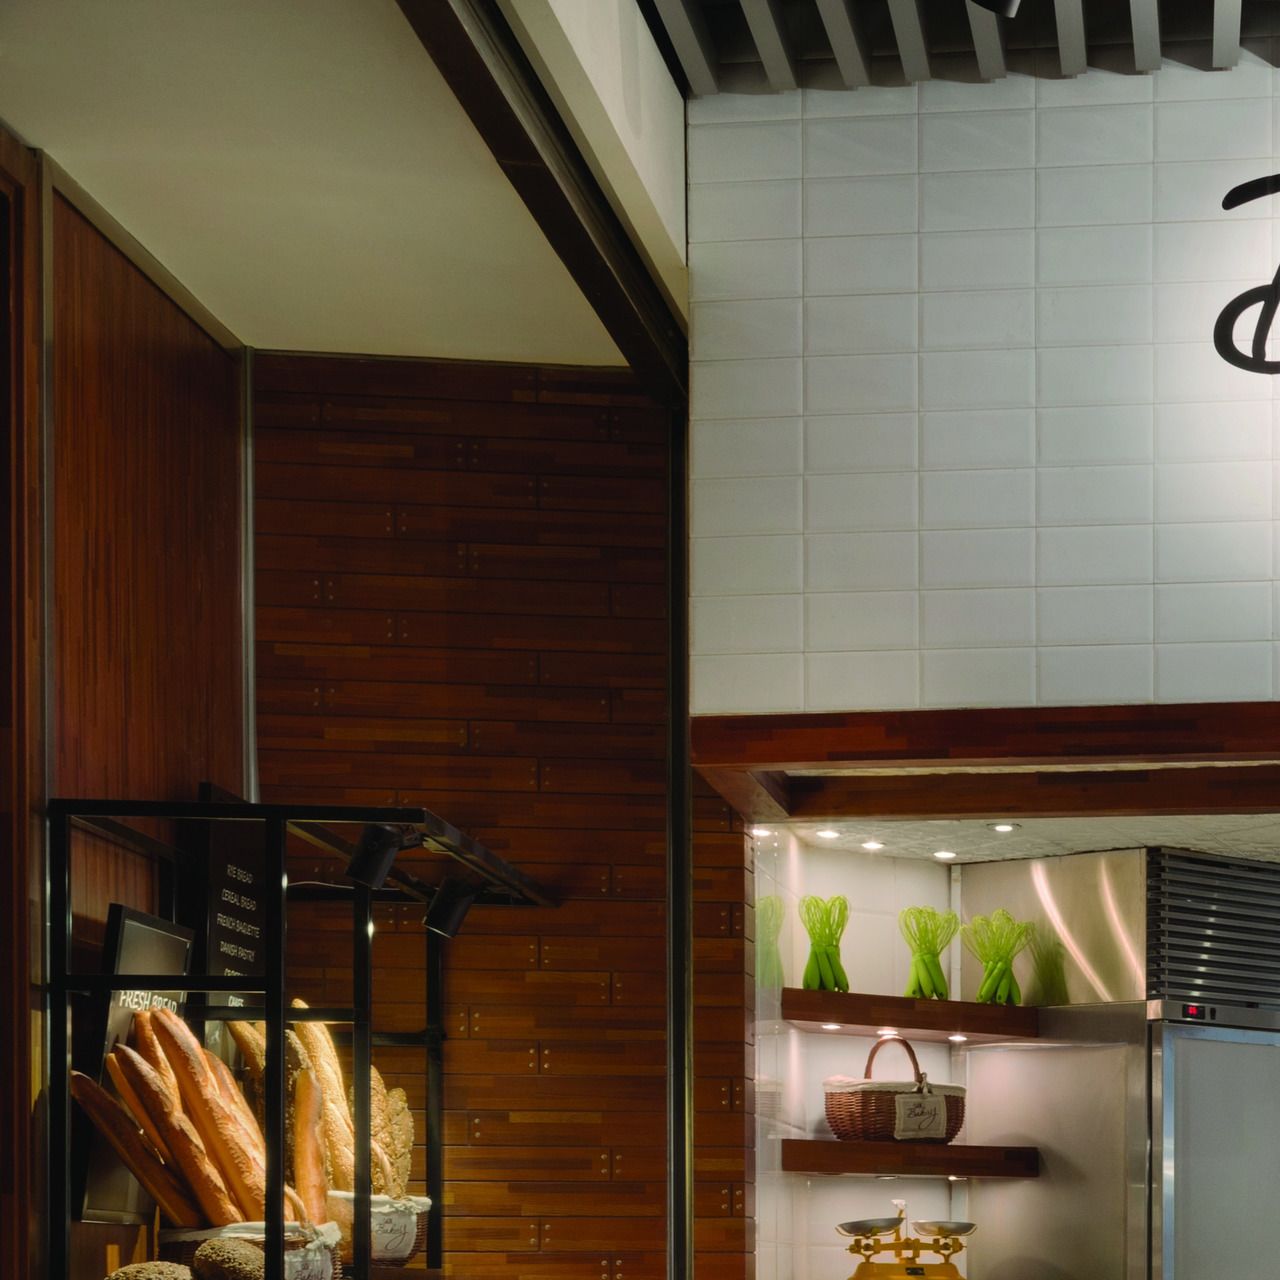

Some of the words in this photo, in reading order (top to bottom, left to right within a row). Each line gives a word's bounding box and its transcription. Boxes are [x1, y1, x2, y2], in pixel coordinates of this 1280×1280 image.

[240, 895, 257, 911] BREAD
[217, 912, 236, 930] FRENCH
[120, 990, 152, 1011] FRESH
